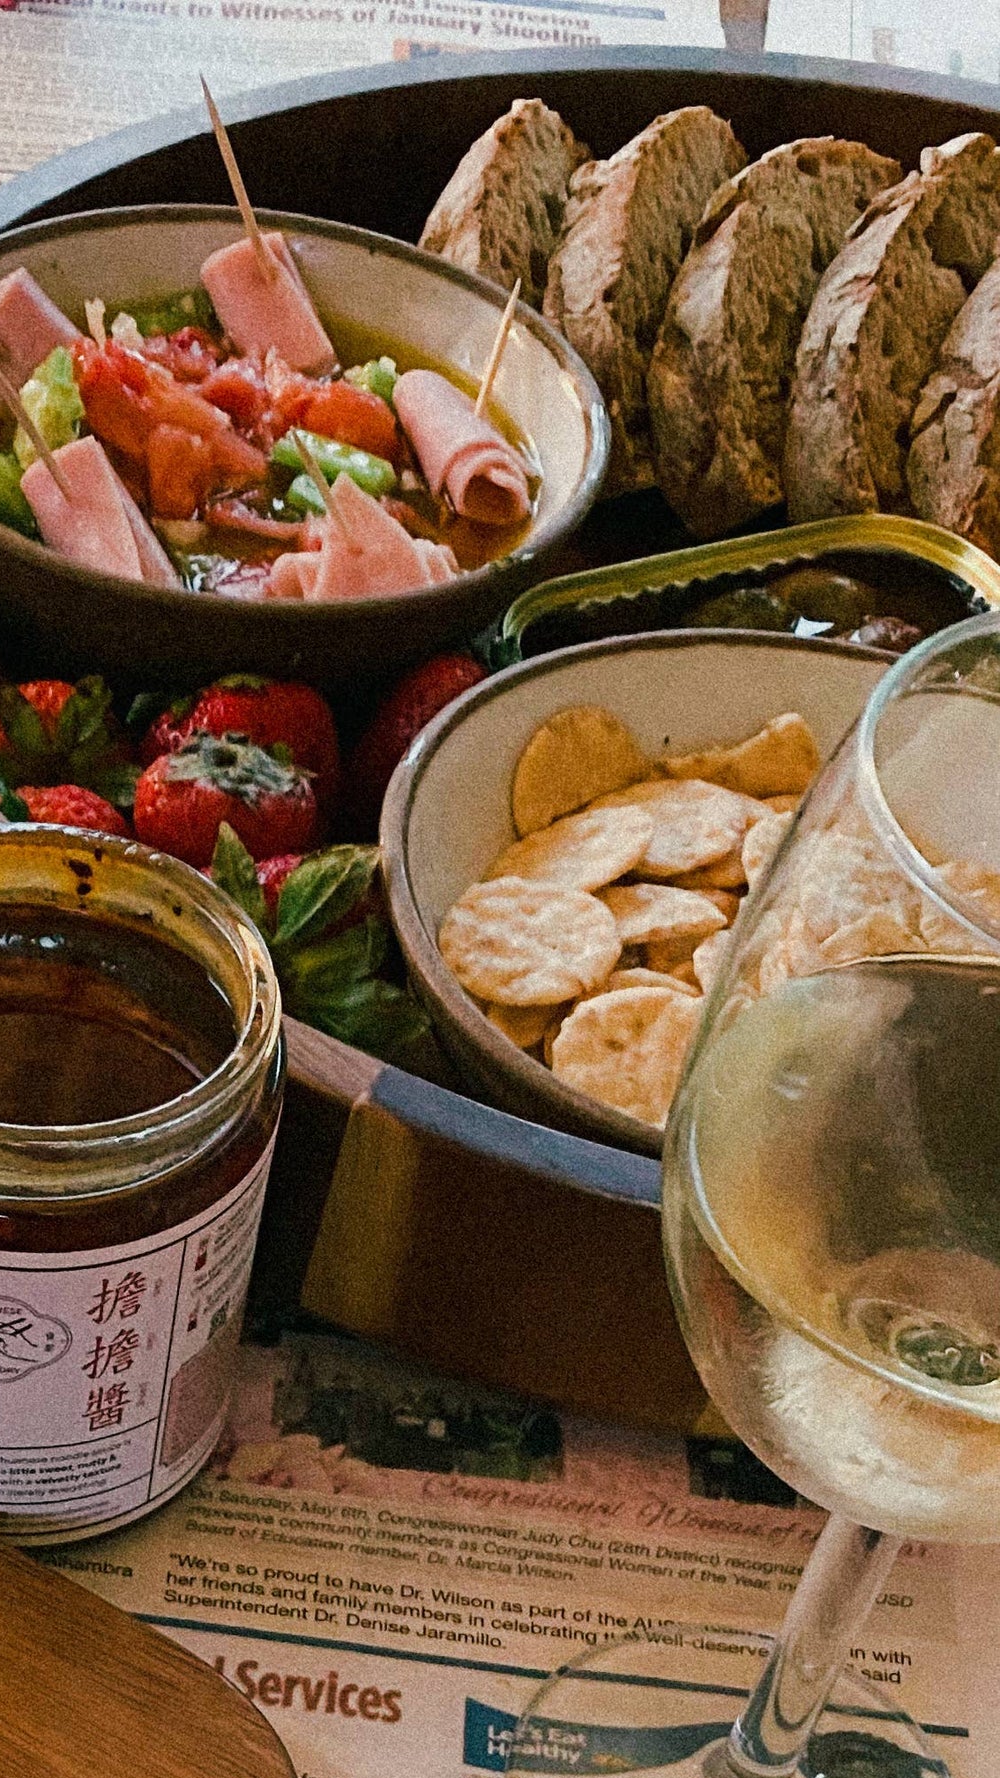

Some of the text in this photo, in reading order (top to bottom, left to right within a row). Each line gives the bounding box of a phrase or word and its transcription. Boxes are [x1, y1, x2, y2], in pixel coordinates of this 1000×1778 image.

[221, 2, 344, 21] Witnesses
[166, 1570, 196, 1588] her
[201, 1572, 266, 1596] friends
[270, 1581, 307, 1601] and
[312, 1588, 368, 1613] family
[373, 1598, 463, 1623] members
[469, 1610, 485, 1625] in
[491, 1613, 598, 1645] celebrating
[850, 1646, 867, 1662] in
[871, 1649, 913, 1666] with
[235, 1561, 258, 1576] so
[264, 1566, 320, 1591] proud
[325, 1574, 343, 1588] to
[349, 1576, 395, 1597] have
[400, 1584, 425, 1601] Dr.
[432, 1590, 495, 1611] Wilson
[500, 1598, 523, 1612] as
[530, 1602, 567, 1623] part
[572, 1607, 593, 1623] of
[596, 1609, 628, 1627] the
[163, 1588, 902, 1685] Superintendent Dr. Denise Jaramillo. said
[239, 1659, 403, 1724] Services
